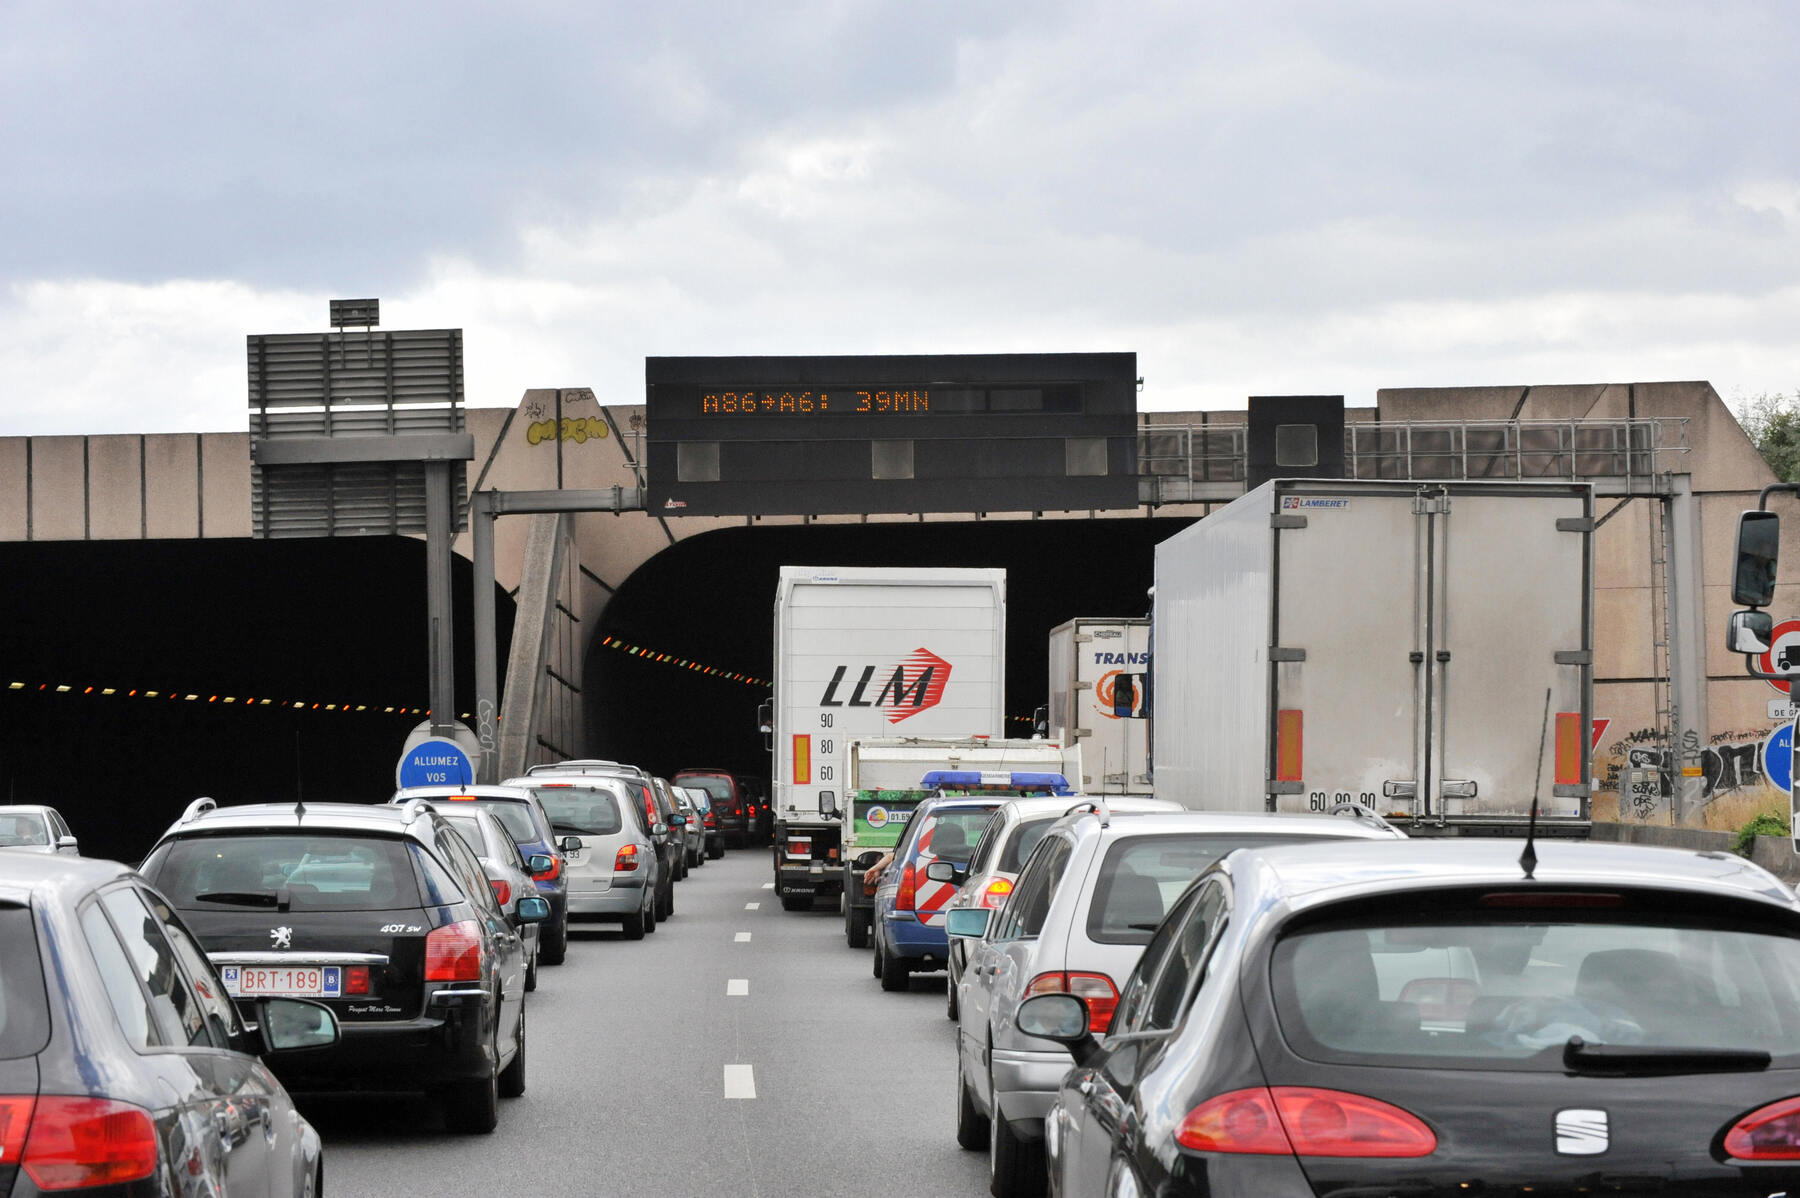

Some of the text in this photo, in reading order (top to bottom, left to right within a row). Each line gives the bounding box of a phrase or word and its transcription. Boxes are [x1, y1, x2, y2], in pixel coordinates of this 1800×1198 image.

[856, 391, 929, 412] 39MN
[1299, 499, 1348, 508] LAMBERET
[1094, 652, 1150, 665] TRANS
[819, 665, 936, 707] LLM
[1774, 709, 1785, 717] DE
[820, 713, 834, 728] 90
[820, 739, 834, 754] 80
[414, 756, 459, 767] ALLUMEZ
[426, 772, 447, 782] VOS
[820, 766, 834, 781] 60
[1310, 792, 1326, 812] 60
[380, 924, 406, 933] 407
